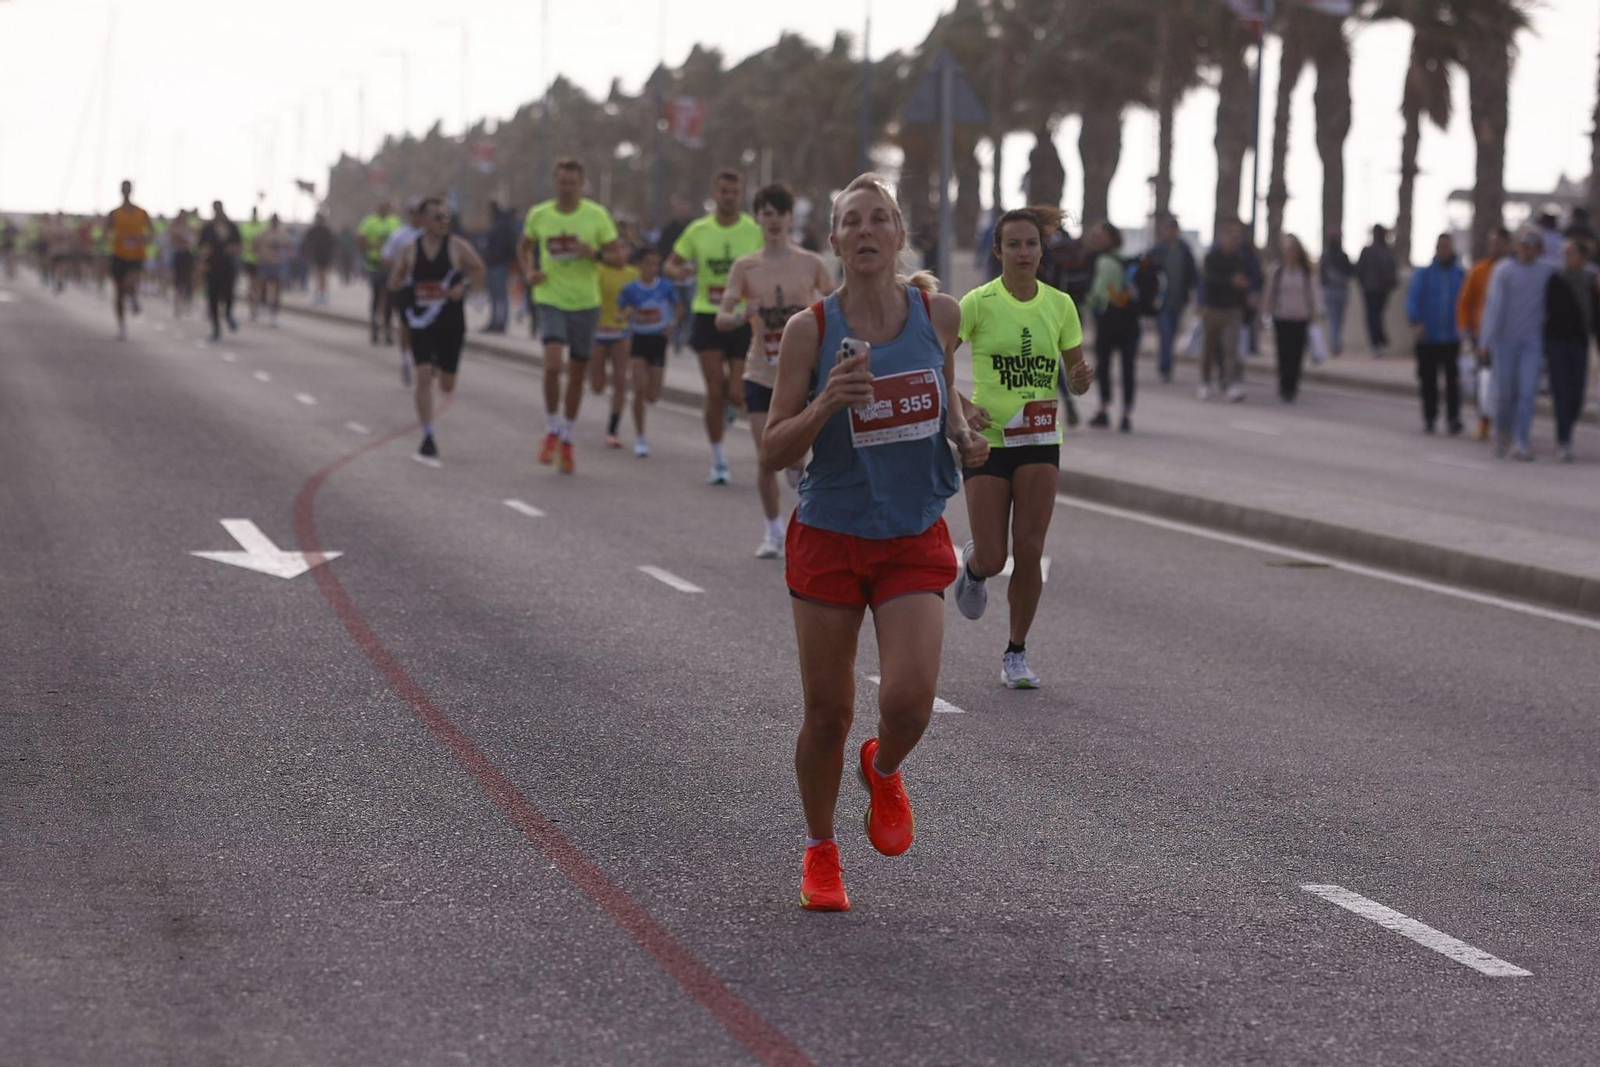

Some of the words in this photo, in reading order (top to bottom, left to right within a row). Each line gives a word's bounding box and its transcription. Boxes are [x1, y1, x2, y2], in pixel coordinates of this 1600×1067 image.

[991, 354, 1056, 373] BRUNCH
[999, 370, 1034, 390] RUN
[899, 393, 932, 414] 355
[1034, 414, 1053, 427] 363
